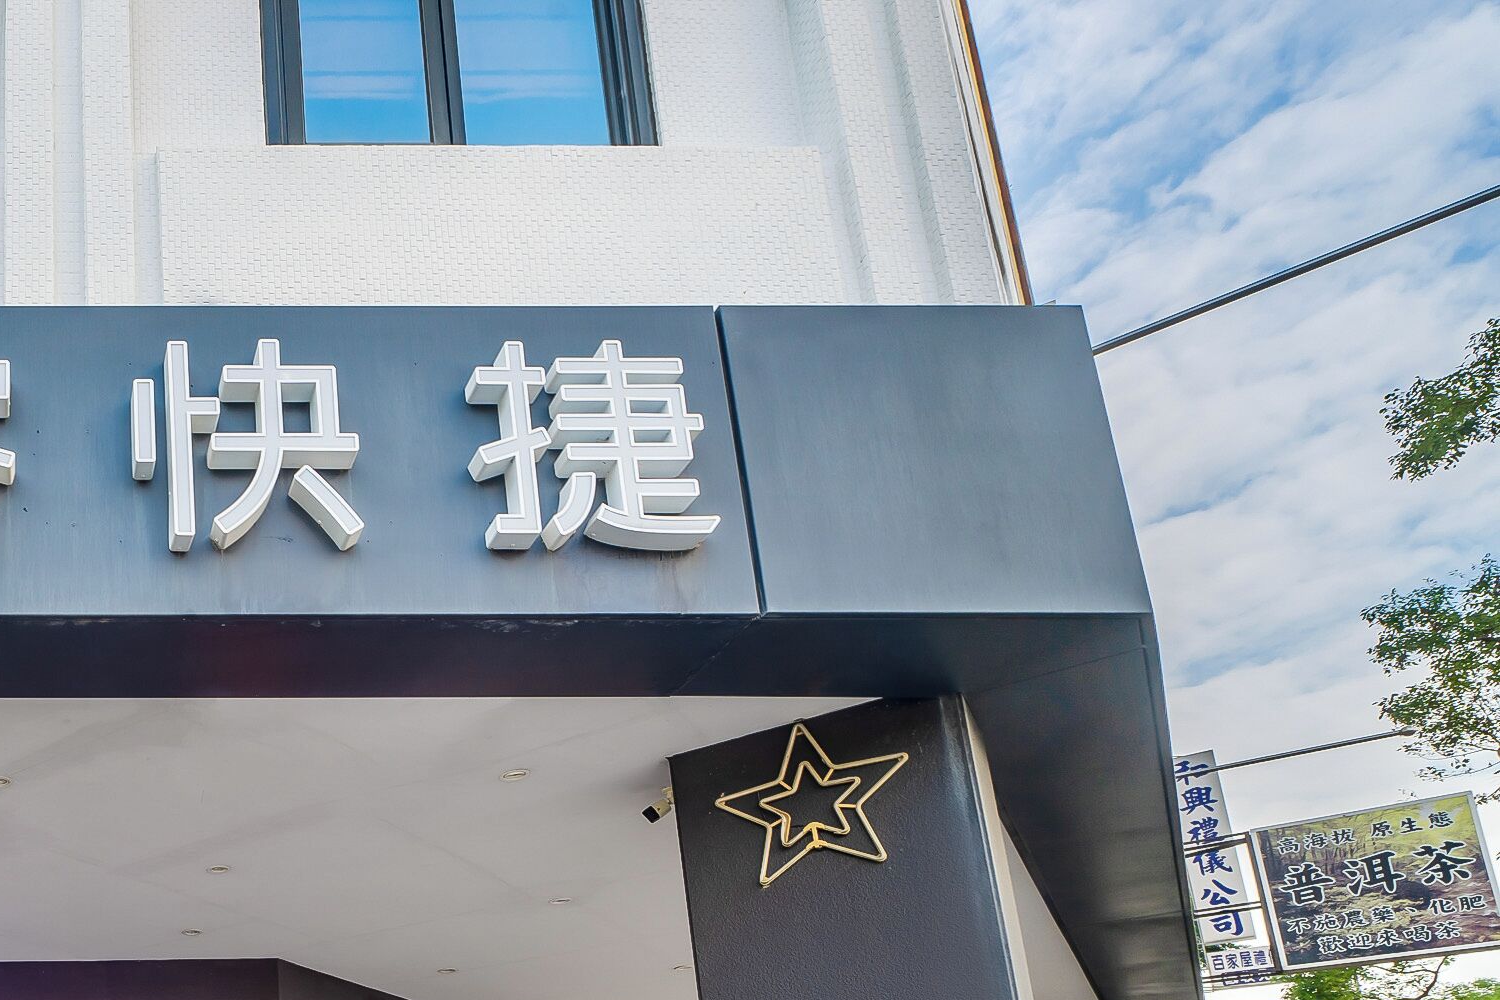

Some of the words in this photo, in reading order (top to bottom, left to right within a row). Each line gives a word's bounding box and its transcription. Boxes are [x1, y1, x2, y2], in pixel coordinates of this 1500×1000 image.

[1279, 829, 1356, 854] 高海拔
[1371, 811, 1454, 837] 原生態
[1280, 841, 1476, 906] 普洱茶
[1317, 921, 1462, 954] 歡迎來喝茶
